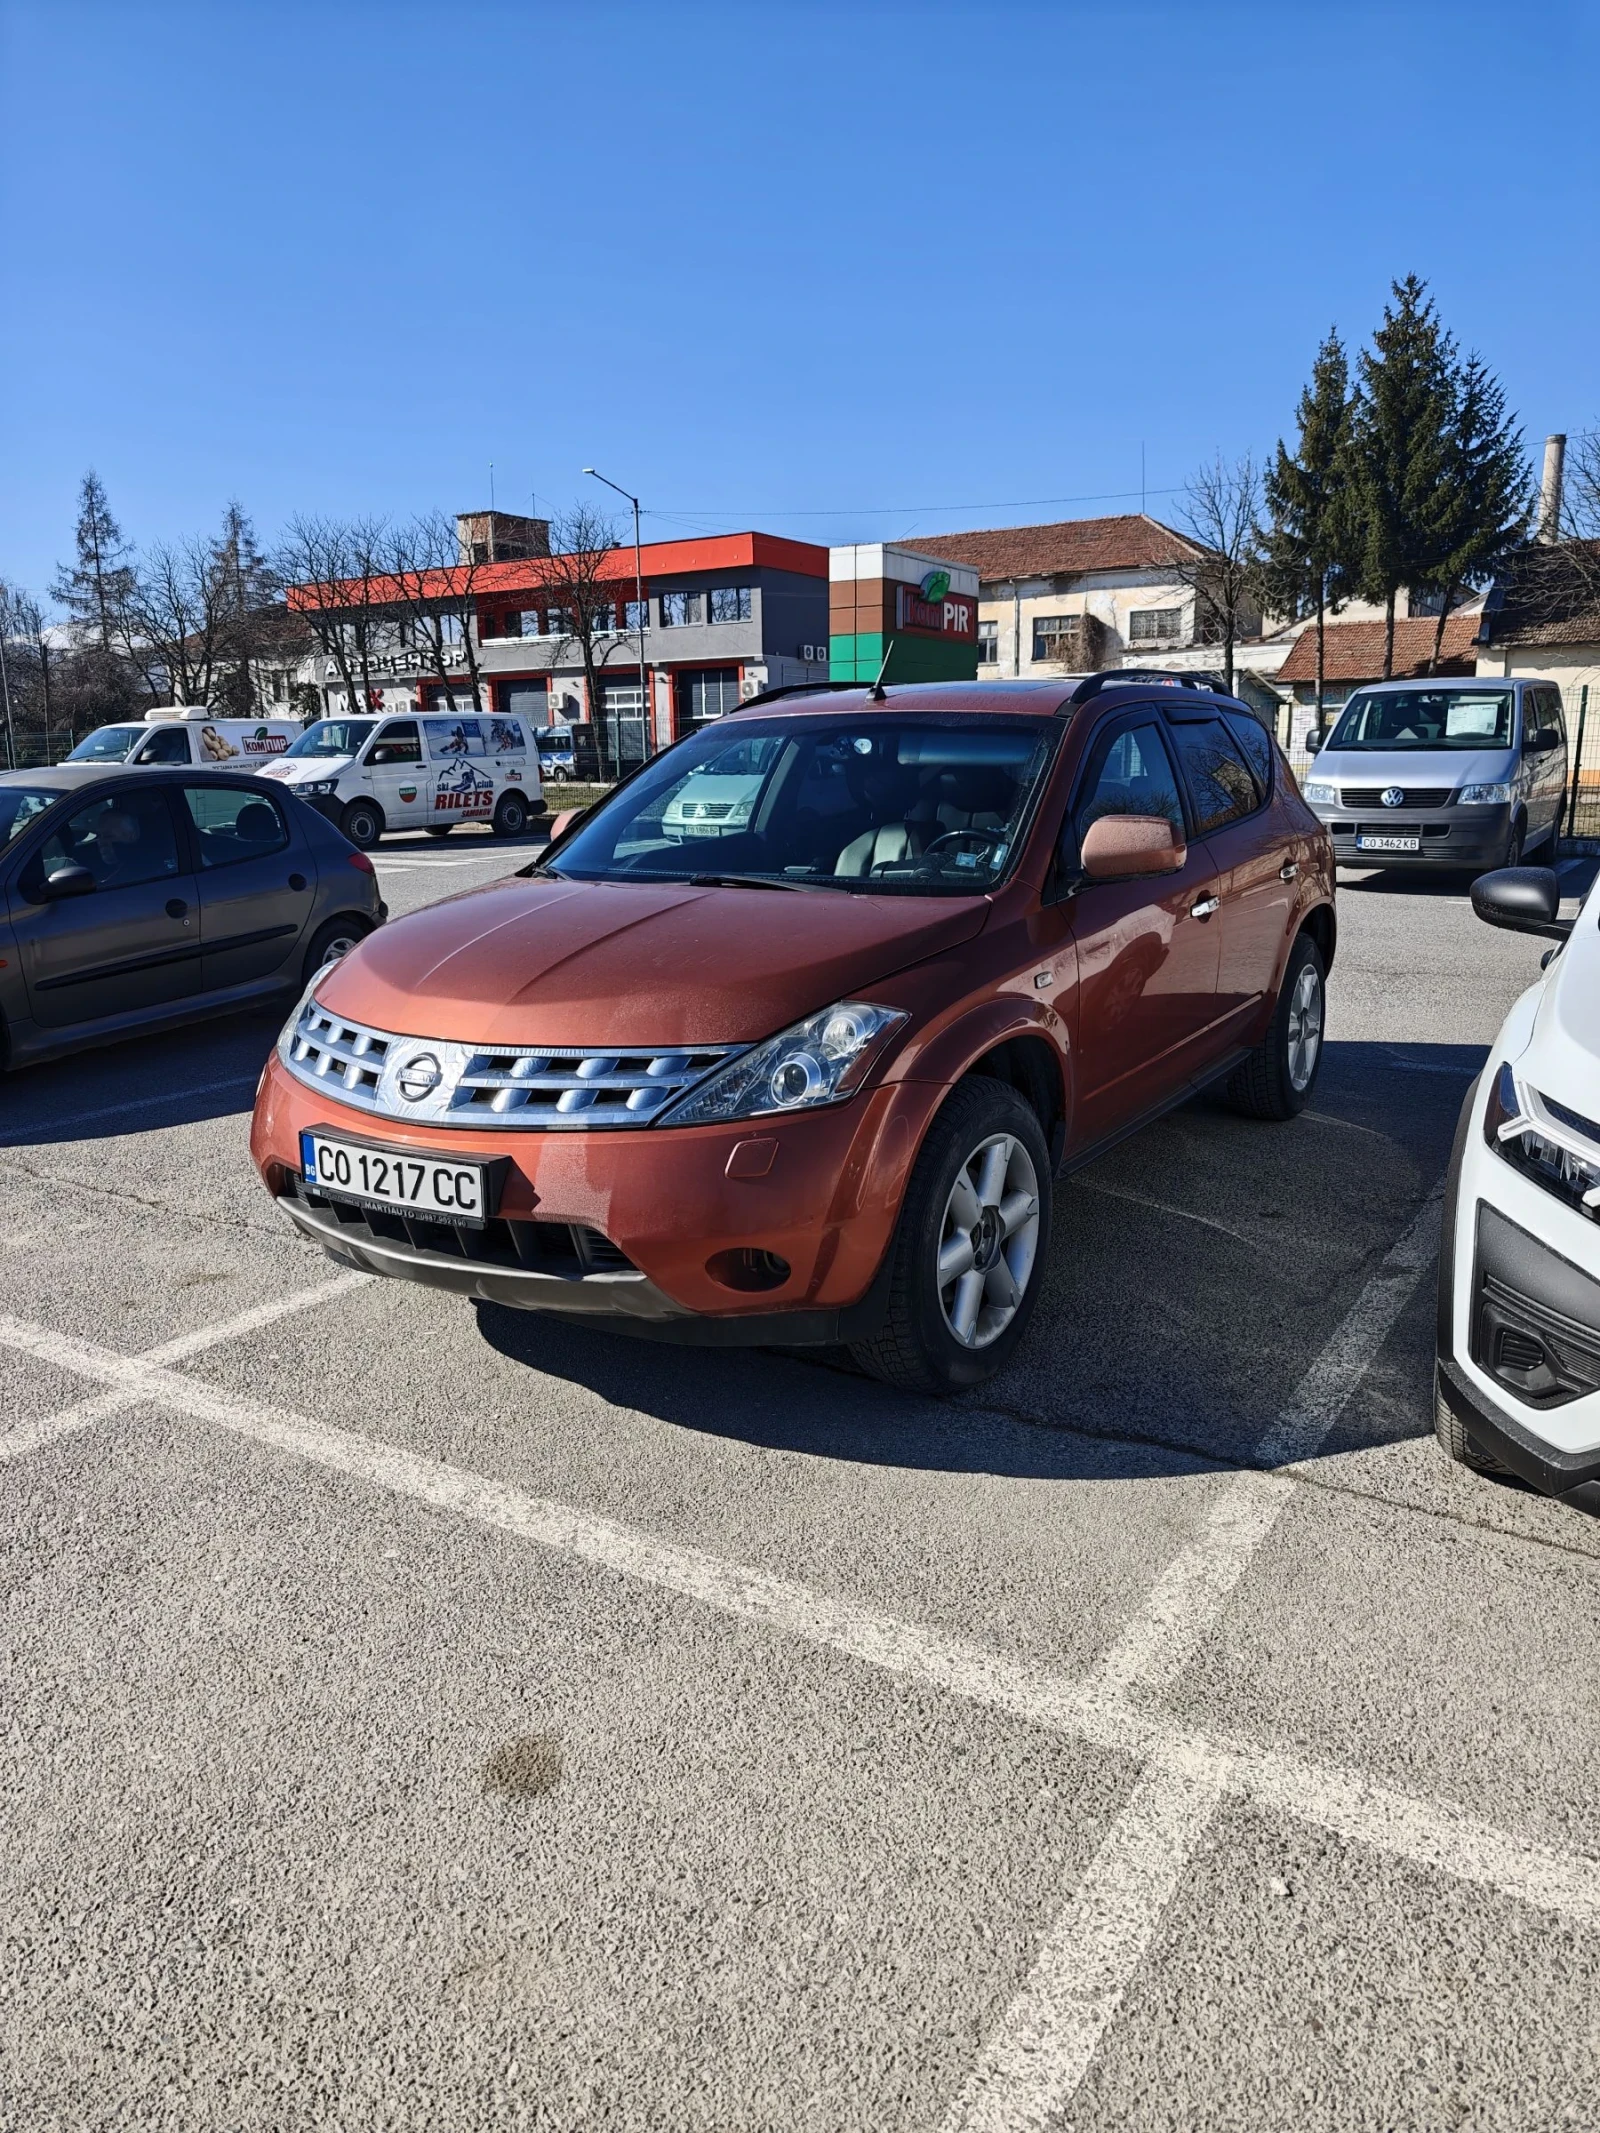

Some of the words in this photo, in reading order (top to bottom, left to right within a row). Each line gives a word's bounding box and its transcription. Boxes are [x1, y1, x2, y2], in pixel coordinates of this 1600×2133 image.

[437, 781, 449, 791] ski
[477, 779, 494, 788] club
[435, 789, 494, 809] RILETS
[461, 807, 492, 818] SAMOKOV
[1377, 838, 1401, 849] 3462
[305, 1163, 316, 1176] BG
[318, 1145, 351, 1185] CO
[359, 1155, 426, 1200] 1217
[433, 1168, 477, 1210] CC
